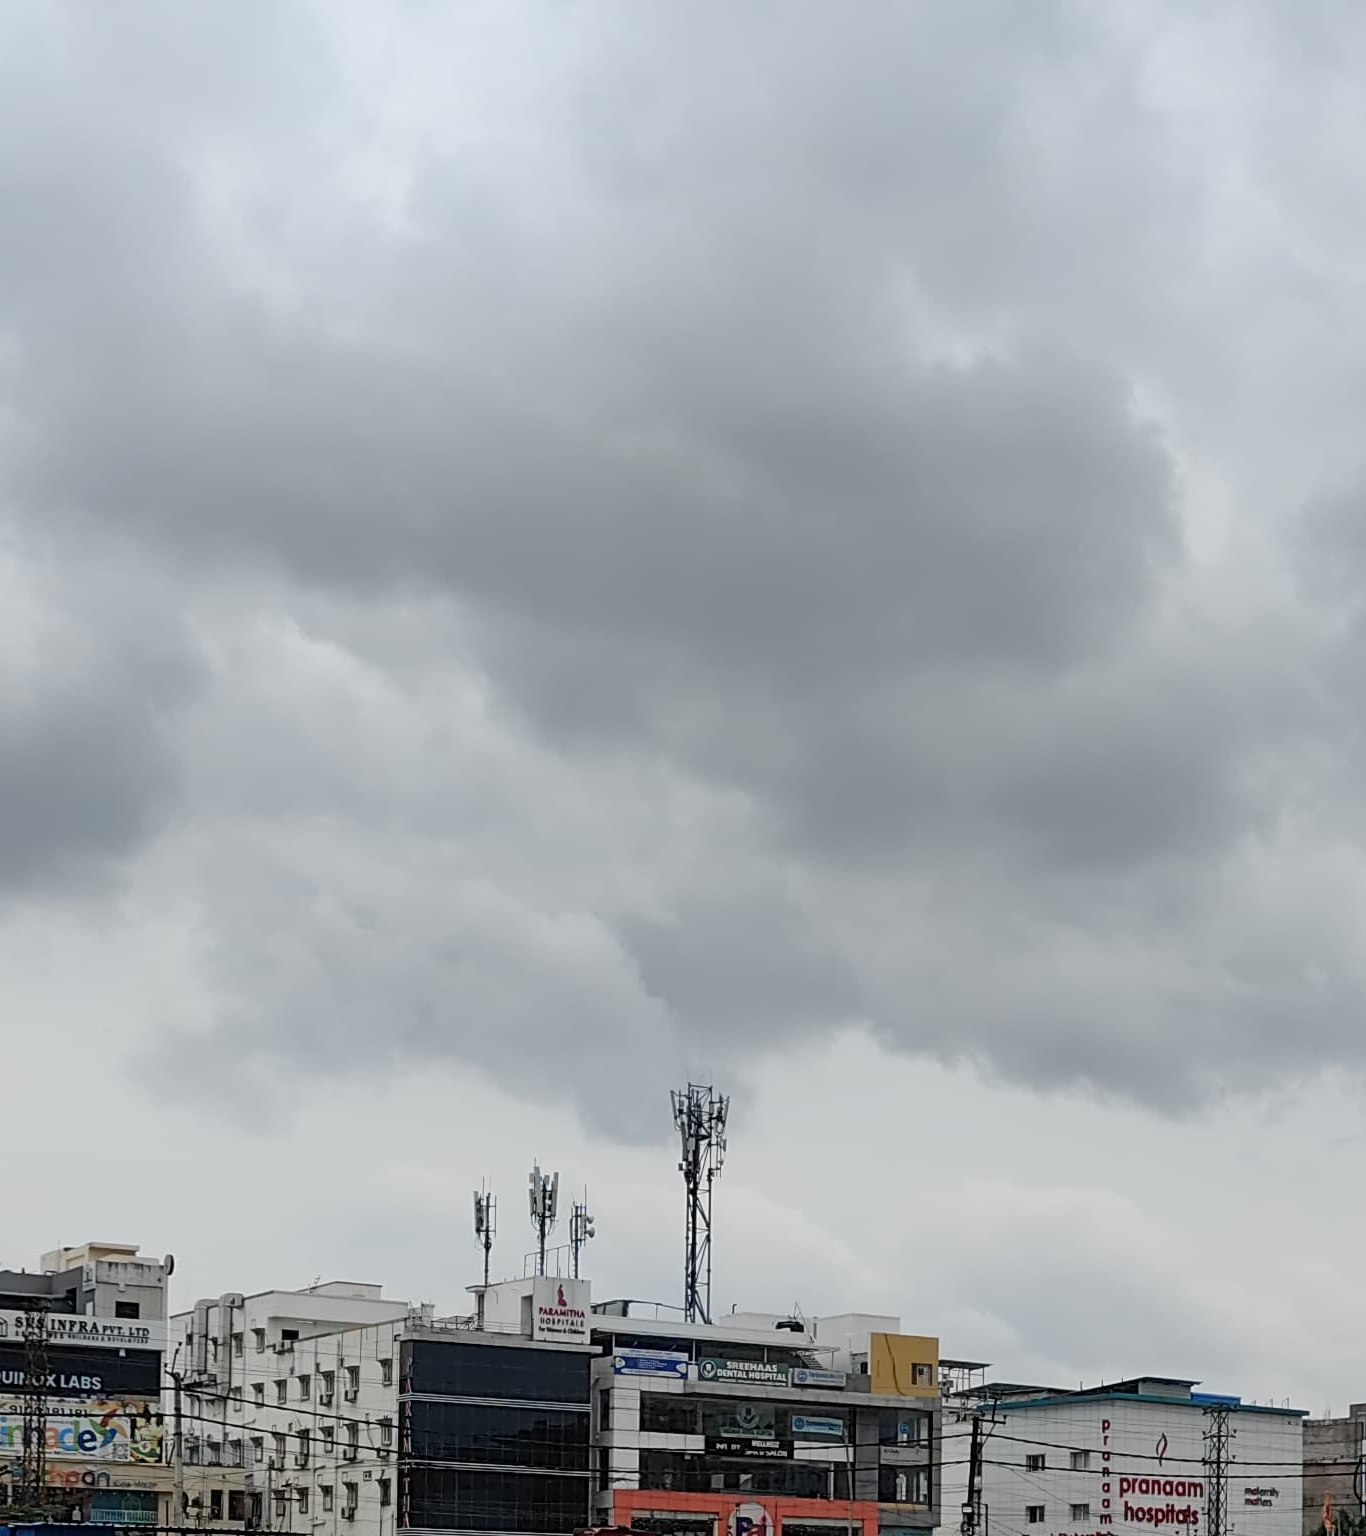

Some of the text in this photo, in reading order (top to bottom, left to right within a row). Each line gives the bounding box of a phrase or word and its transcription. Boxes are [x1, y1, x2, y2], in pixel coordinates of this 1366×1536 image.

[539, 1306, 585, 1318] PARAMITHA
[50, 1319, 99, 1334] INFRA
[129, 1327, 150, 1337] LTD
[540, 1316, 584, 1327] HOSPITALS
[60, 1373, 102, 1390] LABS
[717, 1367, 747, 1379] DENTAL
[748, 1370, 787, 1382] HOSPITAL
[1100, 1419, 1112, 1524] pranaam
[1119, 1476, 1203, 1498] pranaam
[1124, 1501, 1199, 1527] hospitals
